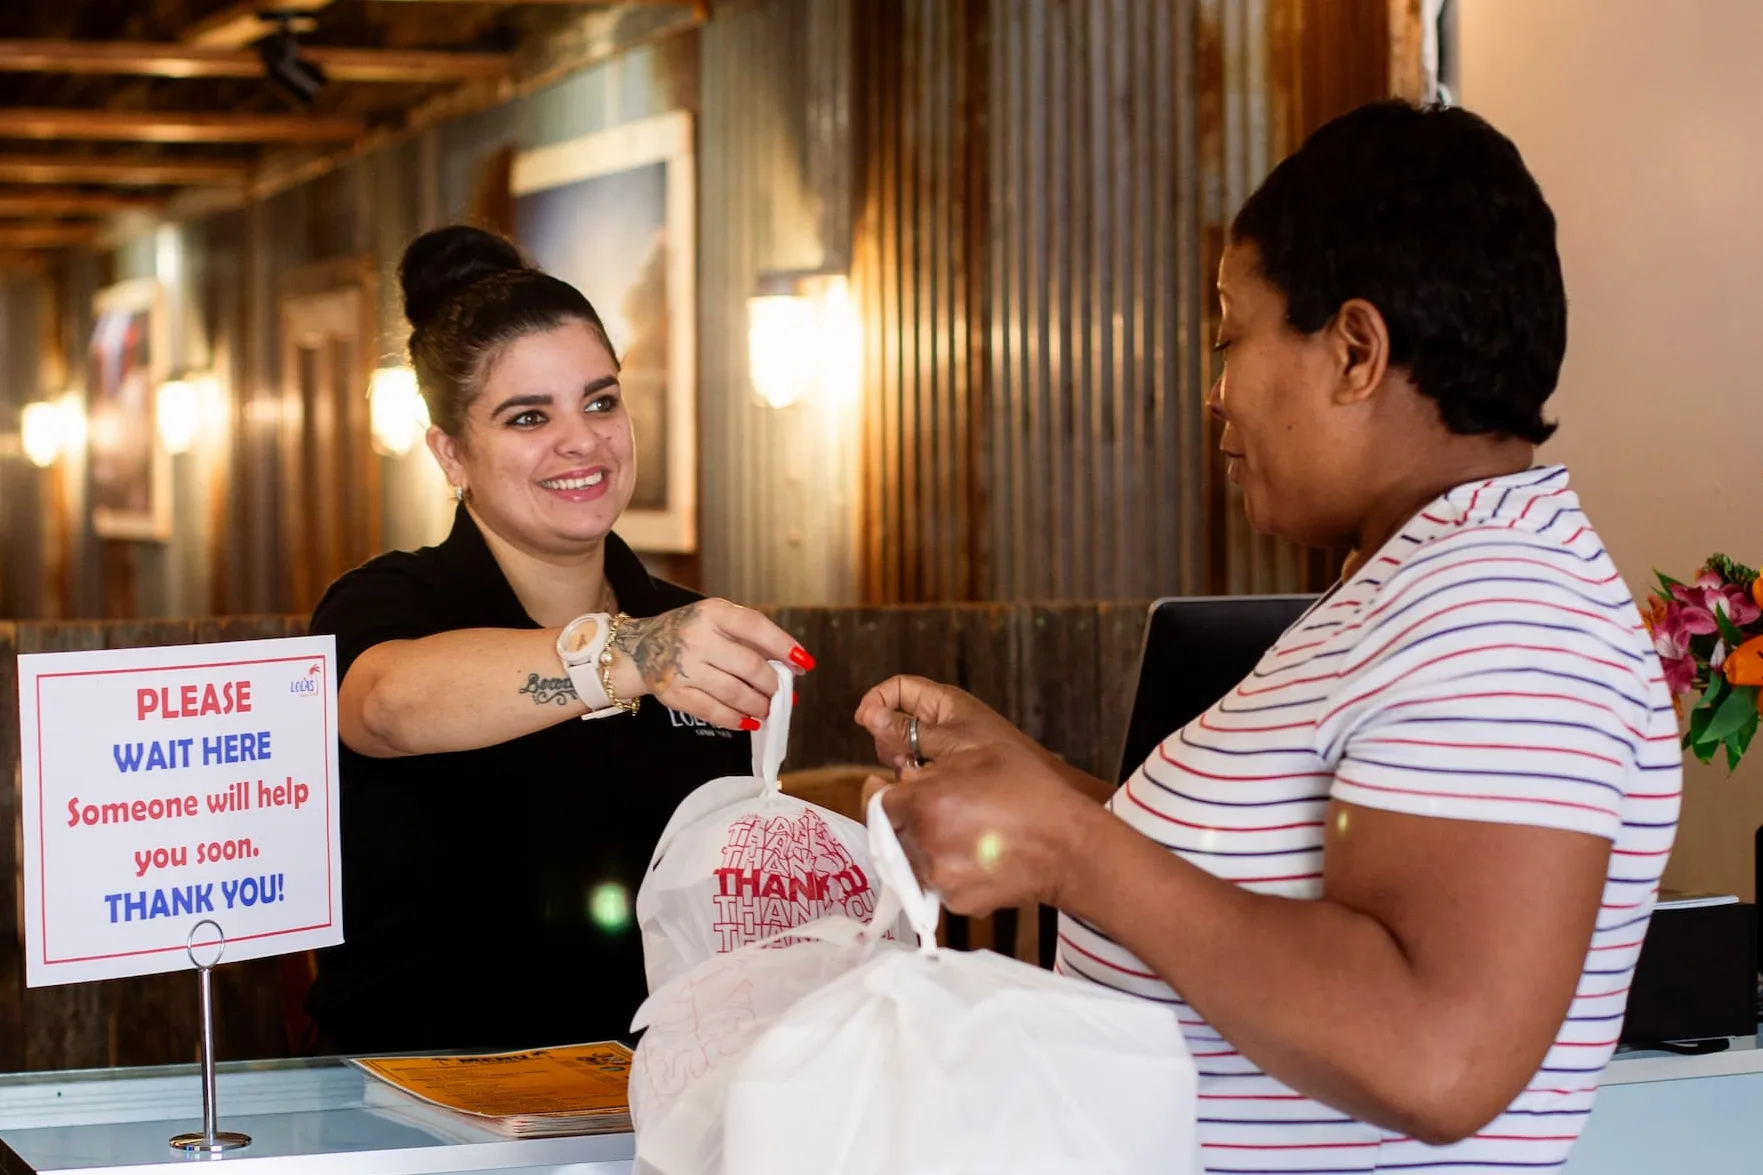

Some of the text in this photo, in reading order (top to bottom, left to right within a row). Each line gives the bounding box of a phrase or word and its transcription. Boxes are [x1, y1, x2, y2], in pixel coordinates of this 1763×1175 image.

[137, 681, 252, 721] PLEASE
[113, 731, 272, 773] WAIT HERE
[67, 776, 310, 827] Someone will help
[134, 837, 260, 878] you soon.
[104, 873, 284, 924] THANK YOU!
